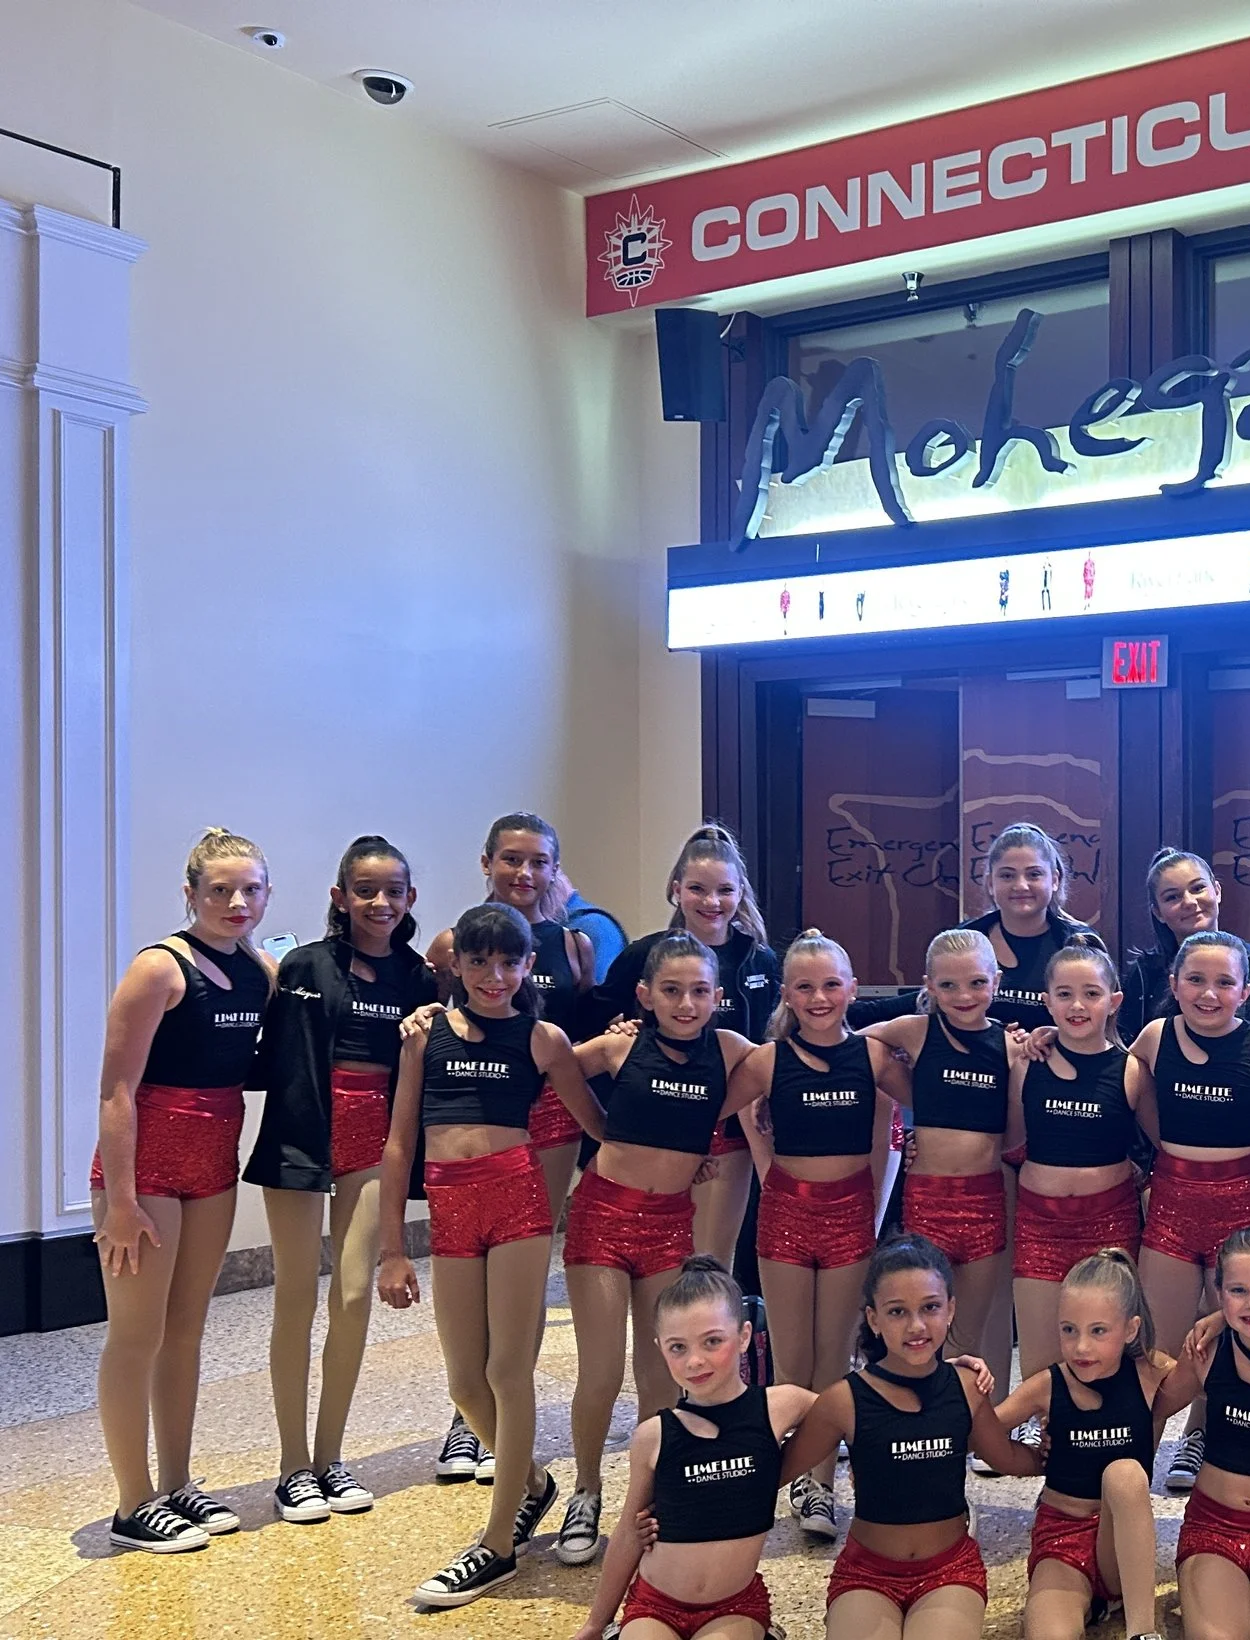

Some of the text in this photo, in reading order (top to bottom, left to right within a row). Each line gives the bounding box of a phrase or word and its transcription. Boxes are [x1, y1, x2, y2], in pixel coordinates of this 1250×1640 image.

[1112, 640, 1160, 684] EXIT
[826, 826, 960, 862] Emergen
[827, 857, 895, 888] Exit
[446, 1060, 510, 1074] LIMELITE
[455, 1070, 502, 1080] DANCE STUDIO
[943, 1069, 998, 1084] LIMELITE
[651, 1079, 708, 1096] LIMELITE
[1174, 1081, 1233, 1098] LIMELITE
[802, 1090, 858, 1102] LIMELITE
[1181, 1092, 1226, 1103] DANCE STUDIO
[1045, 1099, 1102, 1114] LIMELITE
[1052, 1109, 1096, 1119] DANCE STUDIO
[1069, 1427, 1132, 1442] LIMELITE
[891, 1437, 953, 1455] LIMELITE
[1078, 1437, 1126, 1448] DANCE STUDIO
[901, 1449, 948, 1462] DANCE STUDIO
[684, 1455, 755, 1478] LIMELITE
[695, 1467, 748, 1484] DANCE STUDIO
